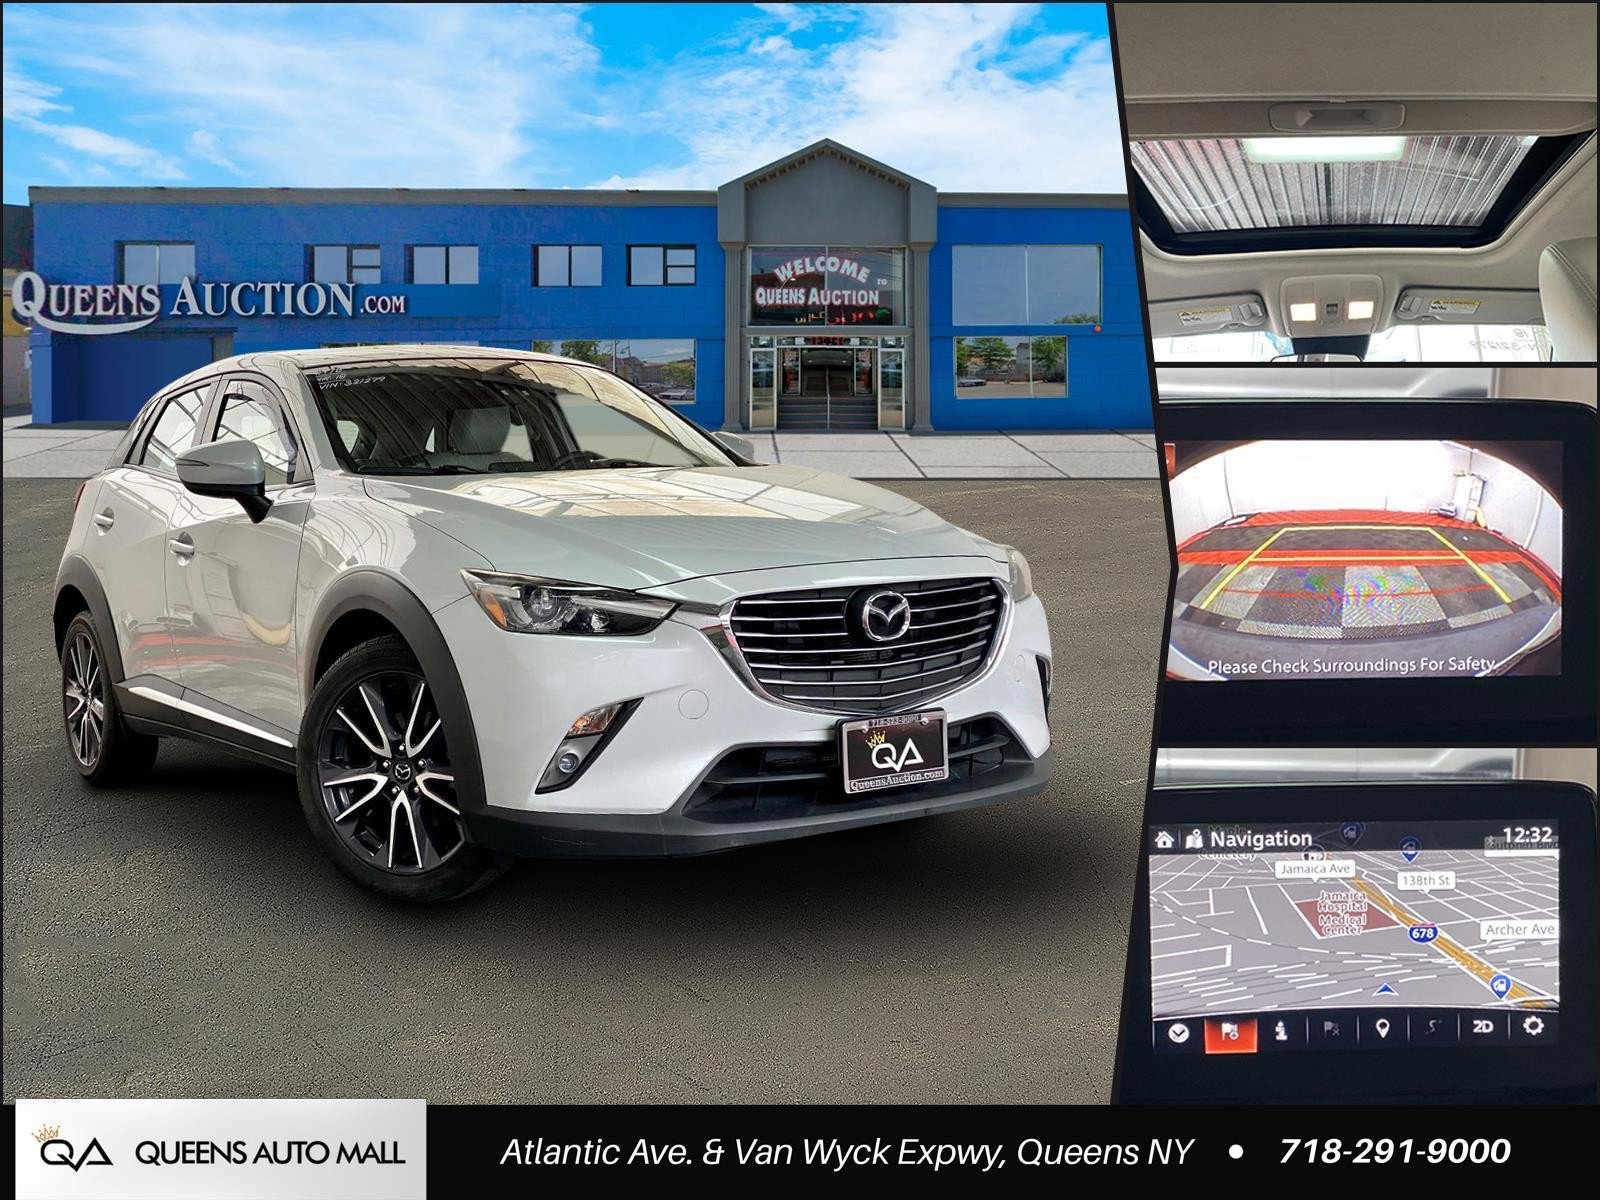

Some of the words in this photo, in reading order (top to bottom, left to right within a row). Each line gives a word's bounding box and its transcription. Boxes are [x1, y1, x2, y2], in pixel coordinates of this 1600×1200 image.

[774, 256, 871, 283] WELCOME
[12, 271, 161, 335] QUEENS
[756, 288, 805, 306] QUEENS
[808, 288, 879, 305] AUCTION
[1208, 660, 1258, 674] Please
[1261, 659, 1309, 674] Check
[1313, 658, 1417, 674] Surroundings
[1420, 657, 1444, 671] For
[1448, 656, 1496, 674] Safety
[850, 769, 944, 791] QueensAuction.com
[1211, 830, 1313, 851] Navigation
[1503, 826, 1553, 843] 12:32
[1281, 864, 1327, 875] Jamaica
[1329, 863, 1352, 874] Ave
[1403, 875, 1436, 886] 138th
[1438, 875, 1449, 886] St
[1320, 890, 1367, 901] Jamaica
[1318, 901, 1367, 913] Hospital
[1319, 914, 1366, 925] Medical
[1322, 925, 1363, 936] Center
[1411, 928, 1434, 939] 678
[1485, 924, 1528, 936] Archer
[1531, 923, 1555, 935] Ave
[1472, 1019, 1494, 1034] 2D
